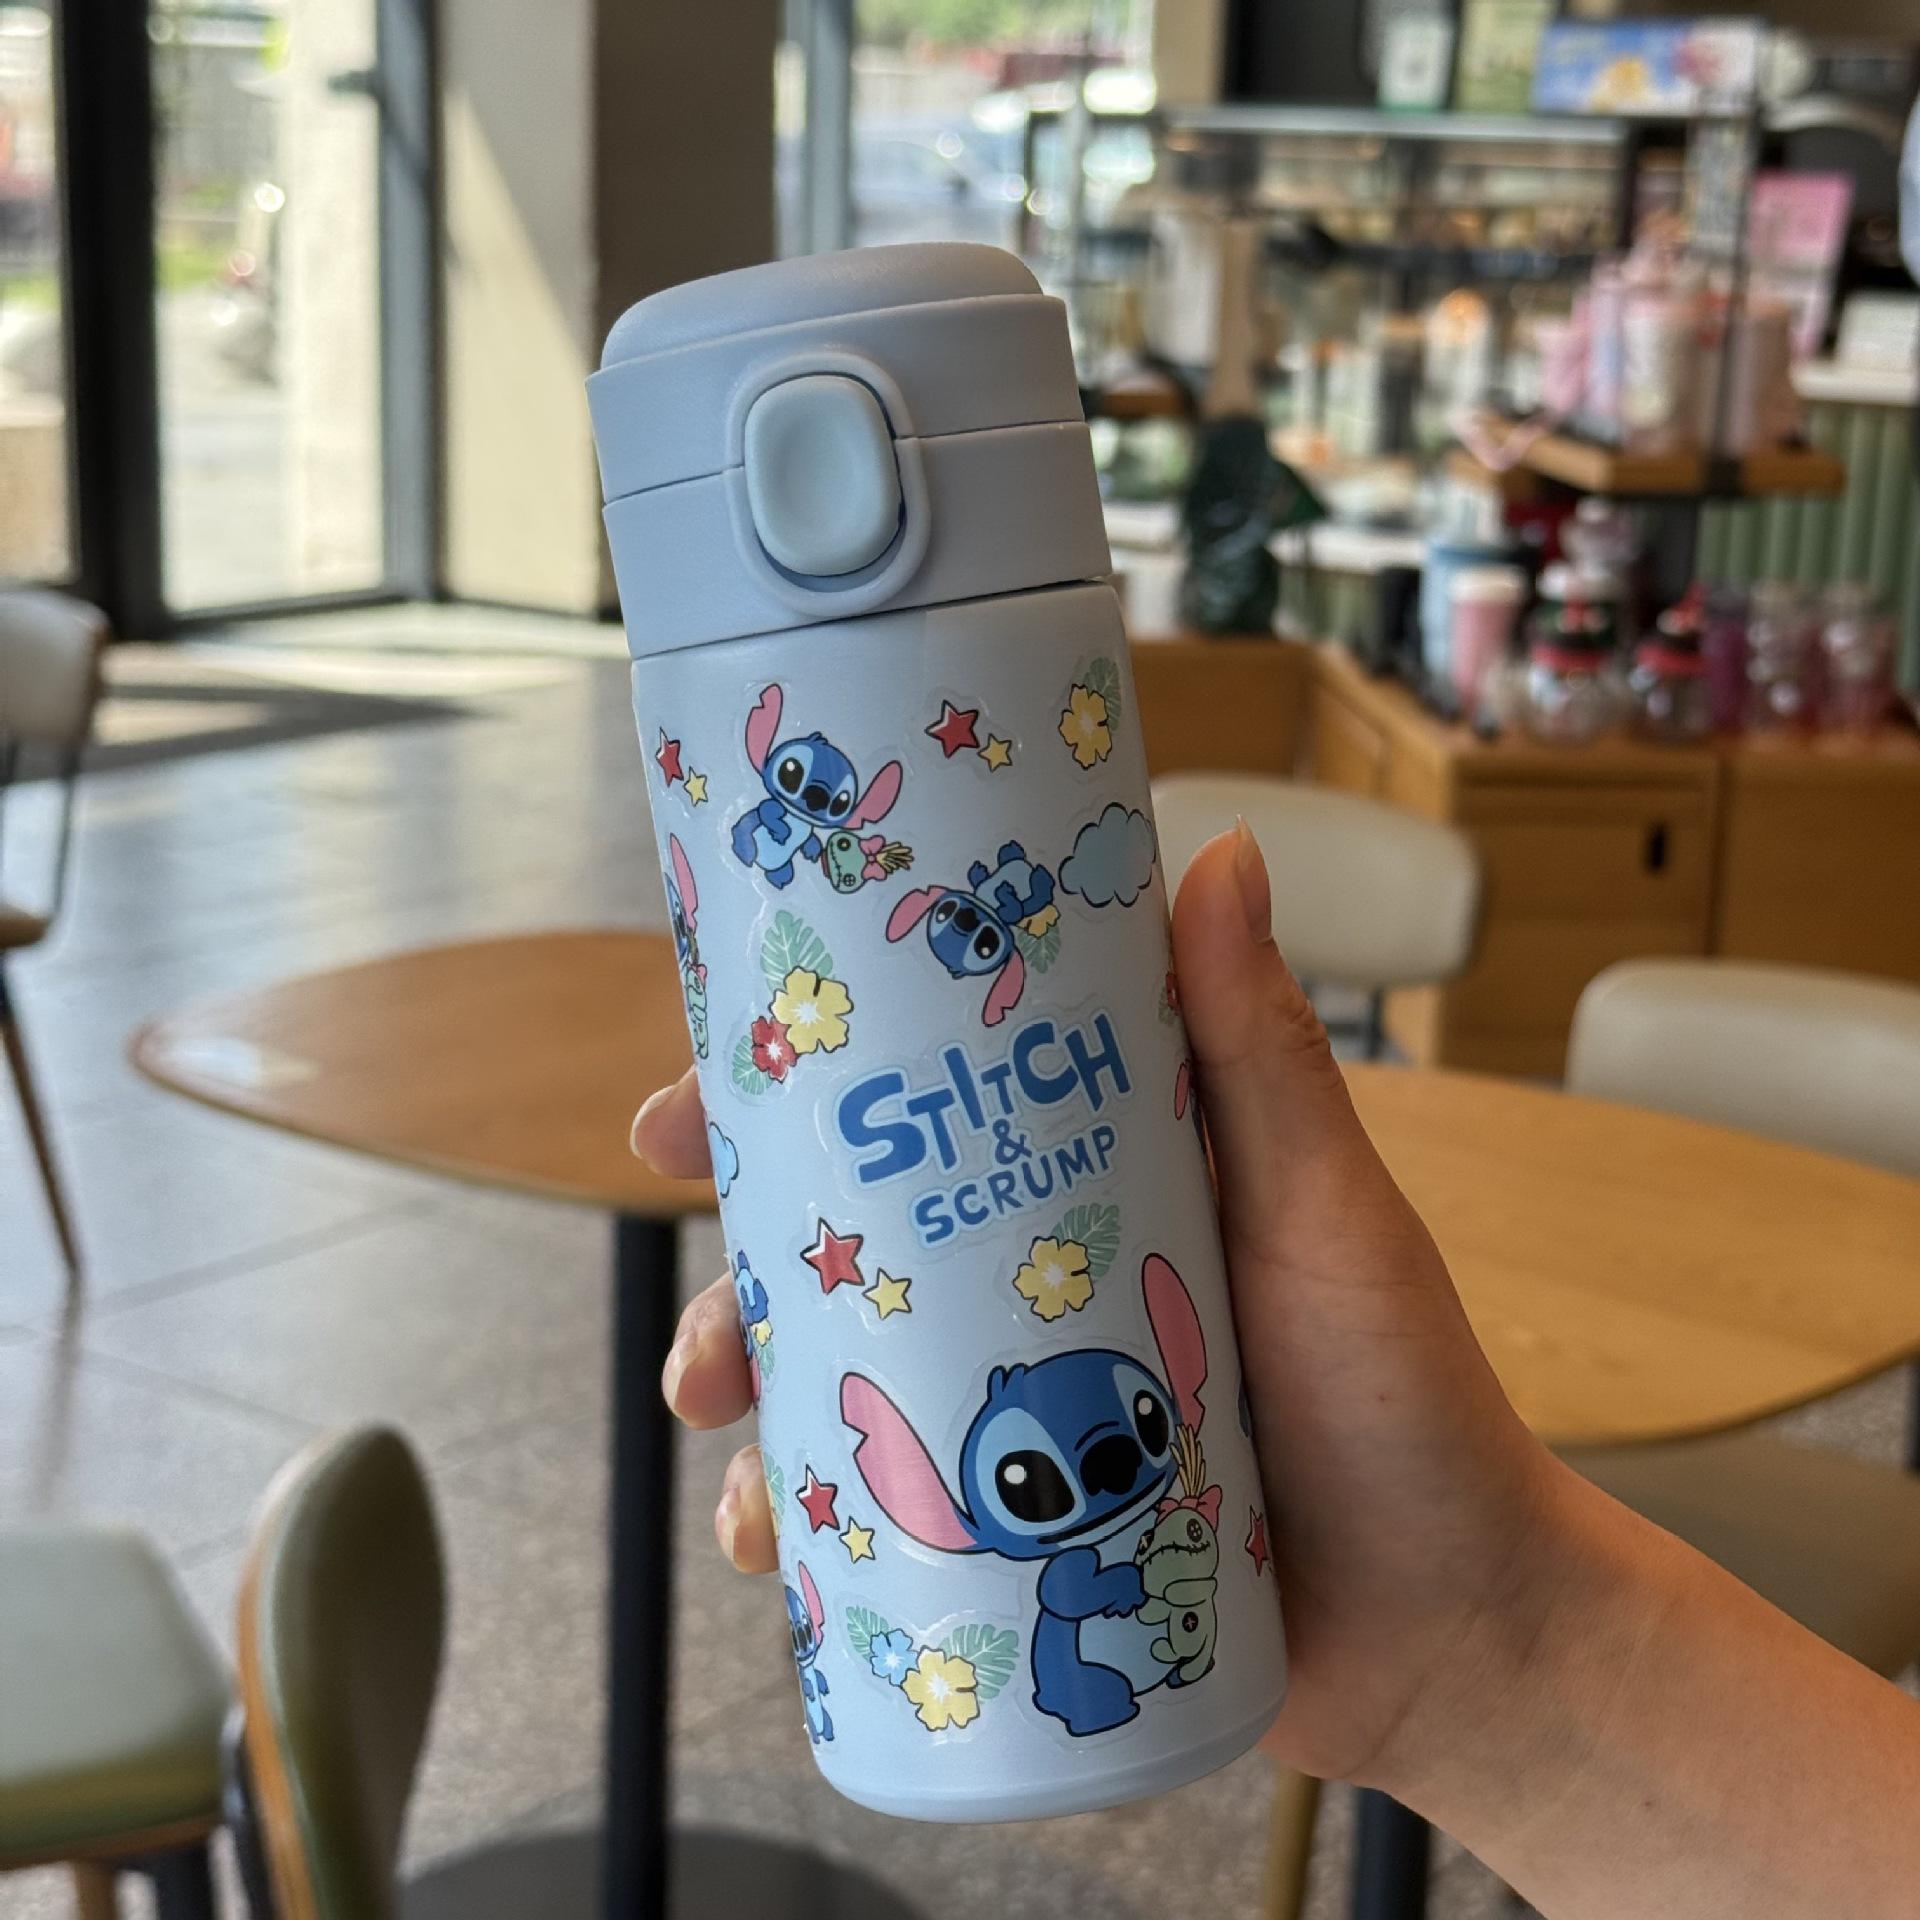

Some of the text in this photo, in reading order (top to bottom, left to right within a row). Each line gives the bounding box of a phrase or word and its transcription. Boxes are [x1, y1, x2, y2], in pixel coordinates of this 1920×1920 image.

[838, 1013, 1130, 1183] STITCH
[992, 1118, 1032, 1164] &
[915, 1125, 1115, 1243] SCRUMP
